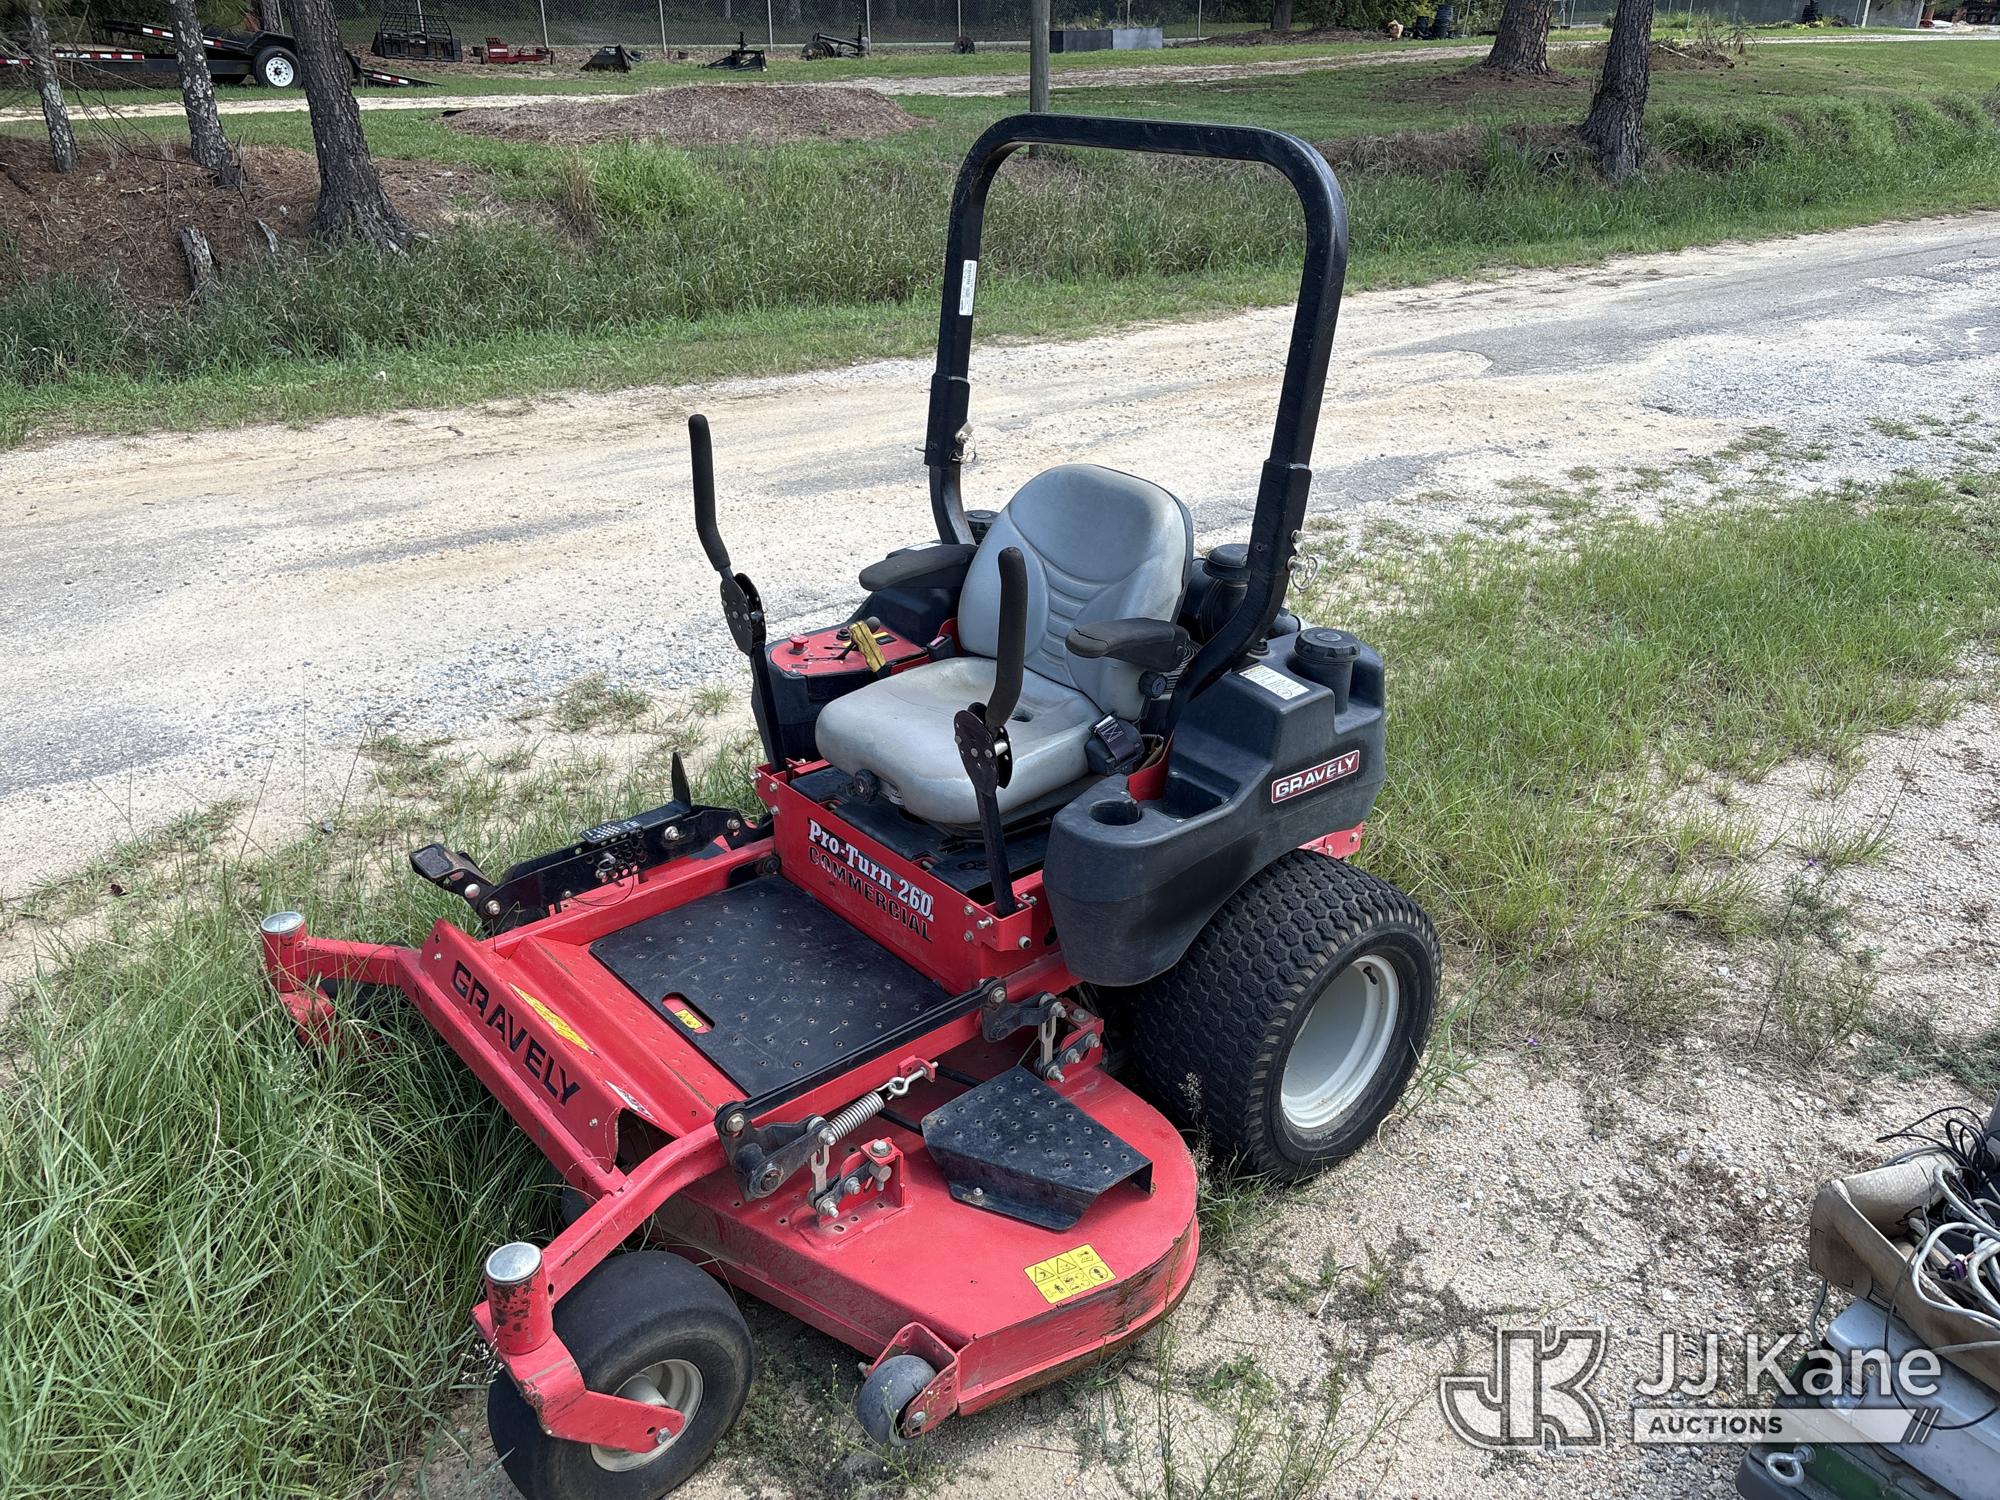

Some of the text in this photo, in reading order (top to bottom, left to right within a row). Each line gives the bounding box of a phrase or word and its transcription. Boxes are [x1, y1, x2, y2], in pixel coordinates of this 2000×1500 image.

[1276, 755, 1356, 798] GRAVELY
[809, 820, 933, 919] Pro-Turn 260
[809, 846, 933, 943] COMMERCIAL
[452, 960, 581, 1107] GRAVELY
